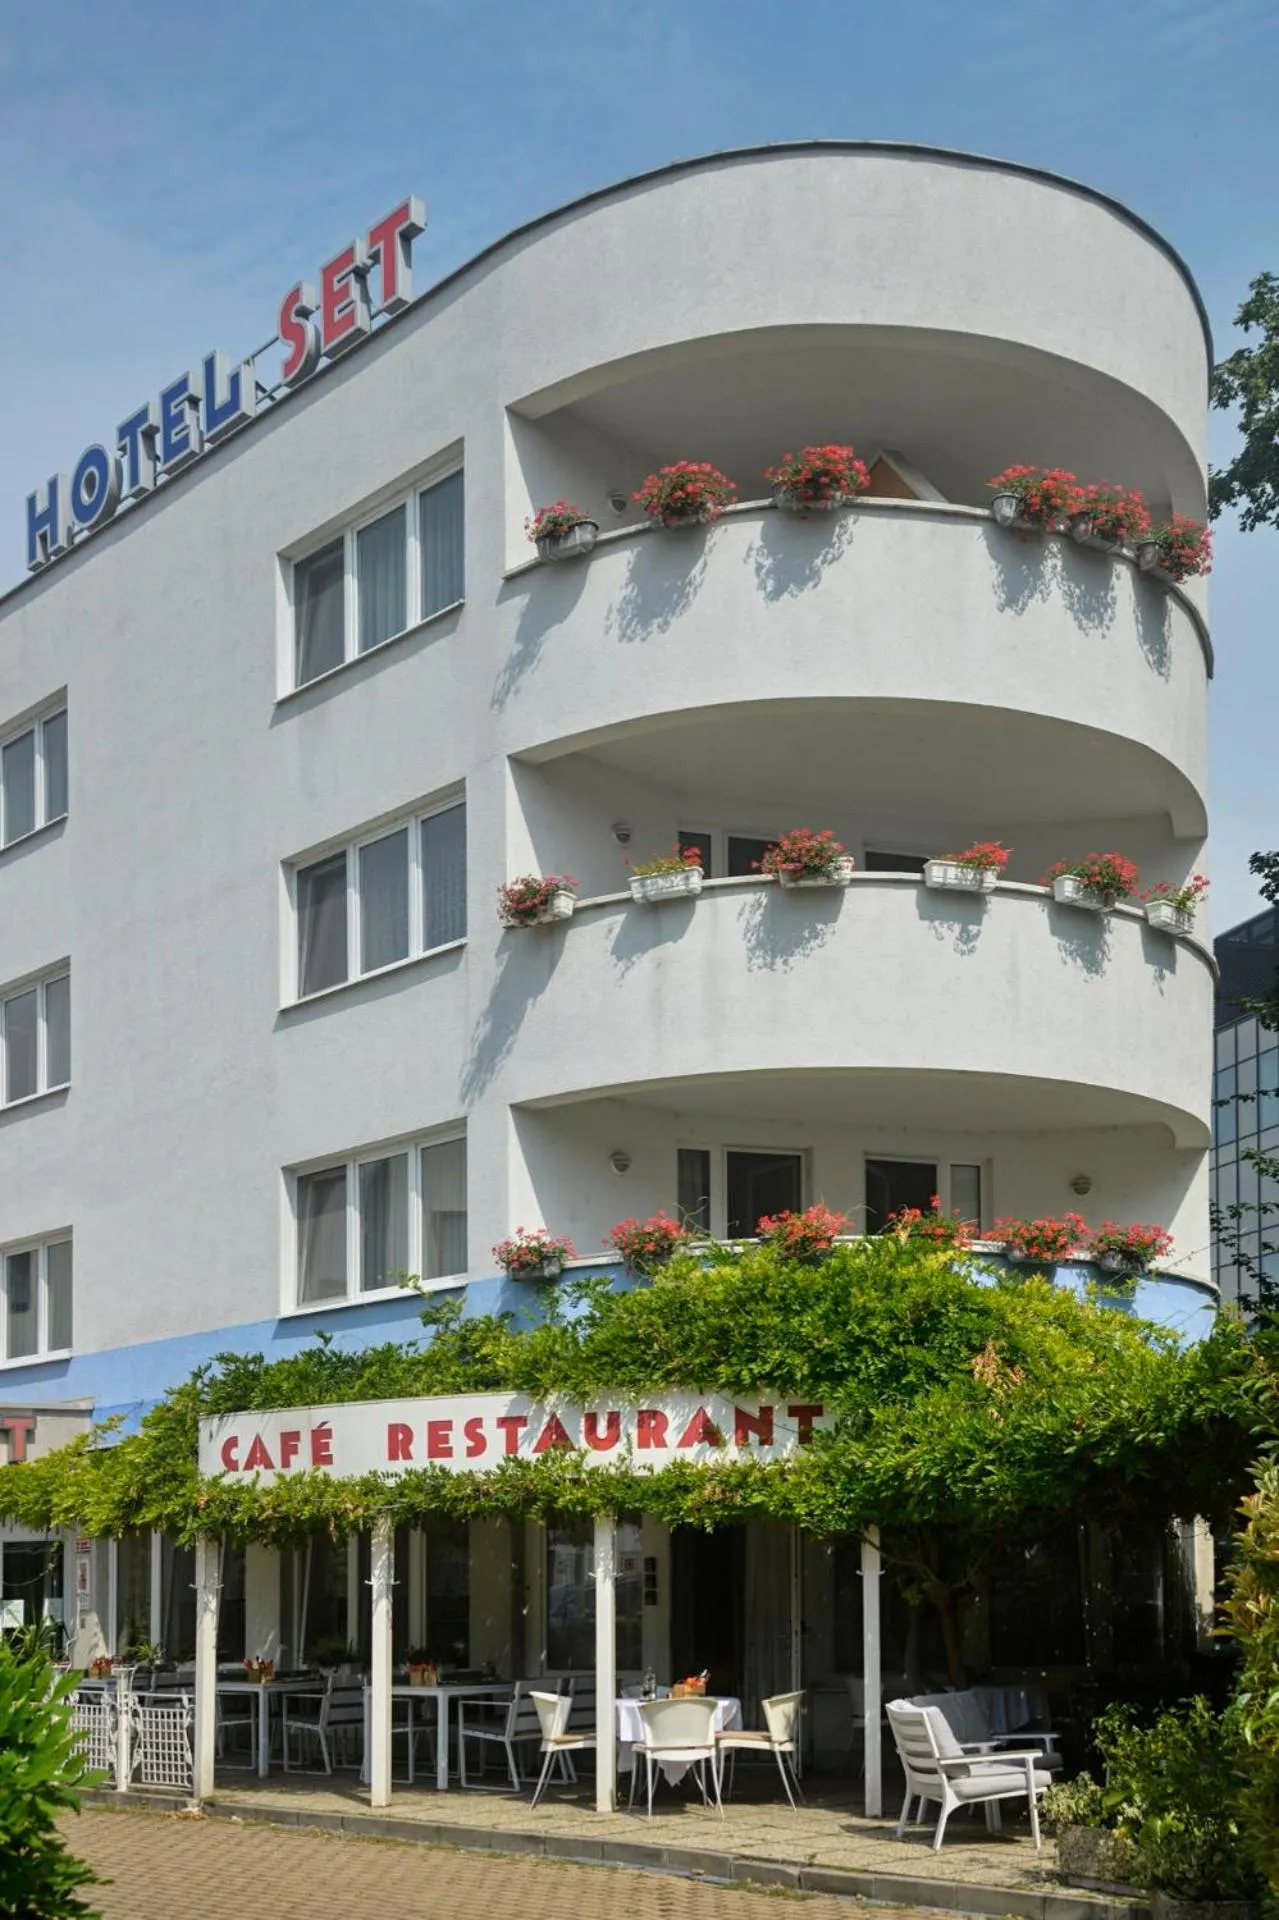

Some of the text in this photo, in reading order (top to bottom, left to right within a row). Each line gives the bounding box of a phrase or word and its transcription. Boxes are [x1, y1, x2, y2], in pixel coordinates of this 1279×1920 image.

[26, 195, 427, 572] HOTEL SET
[221, 1405, 824, 1472] CAFÉ RESTAURANT
